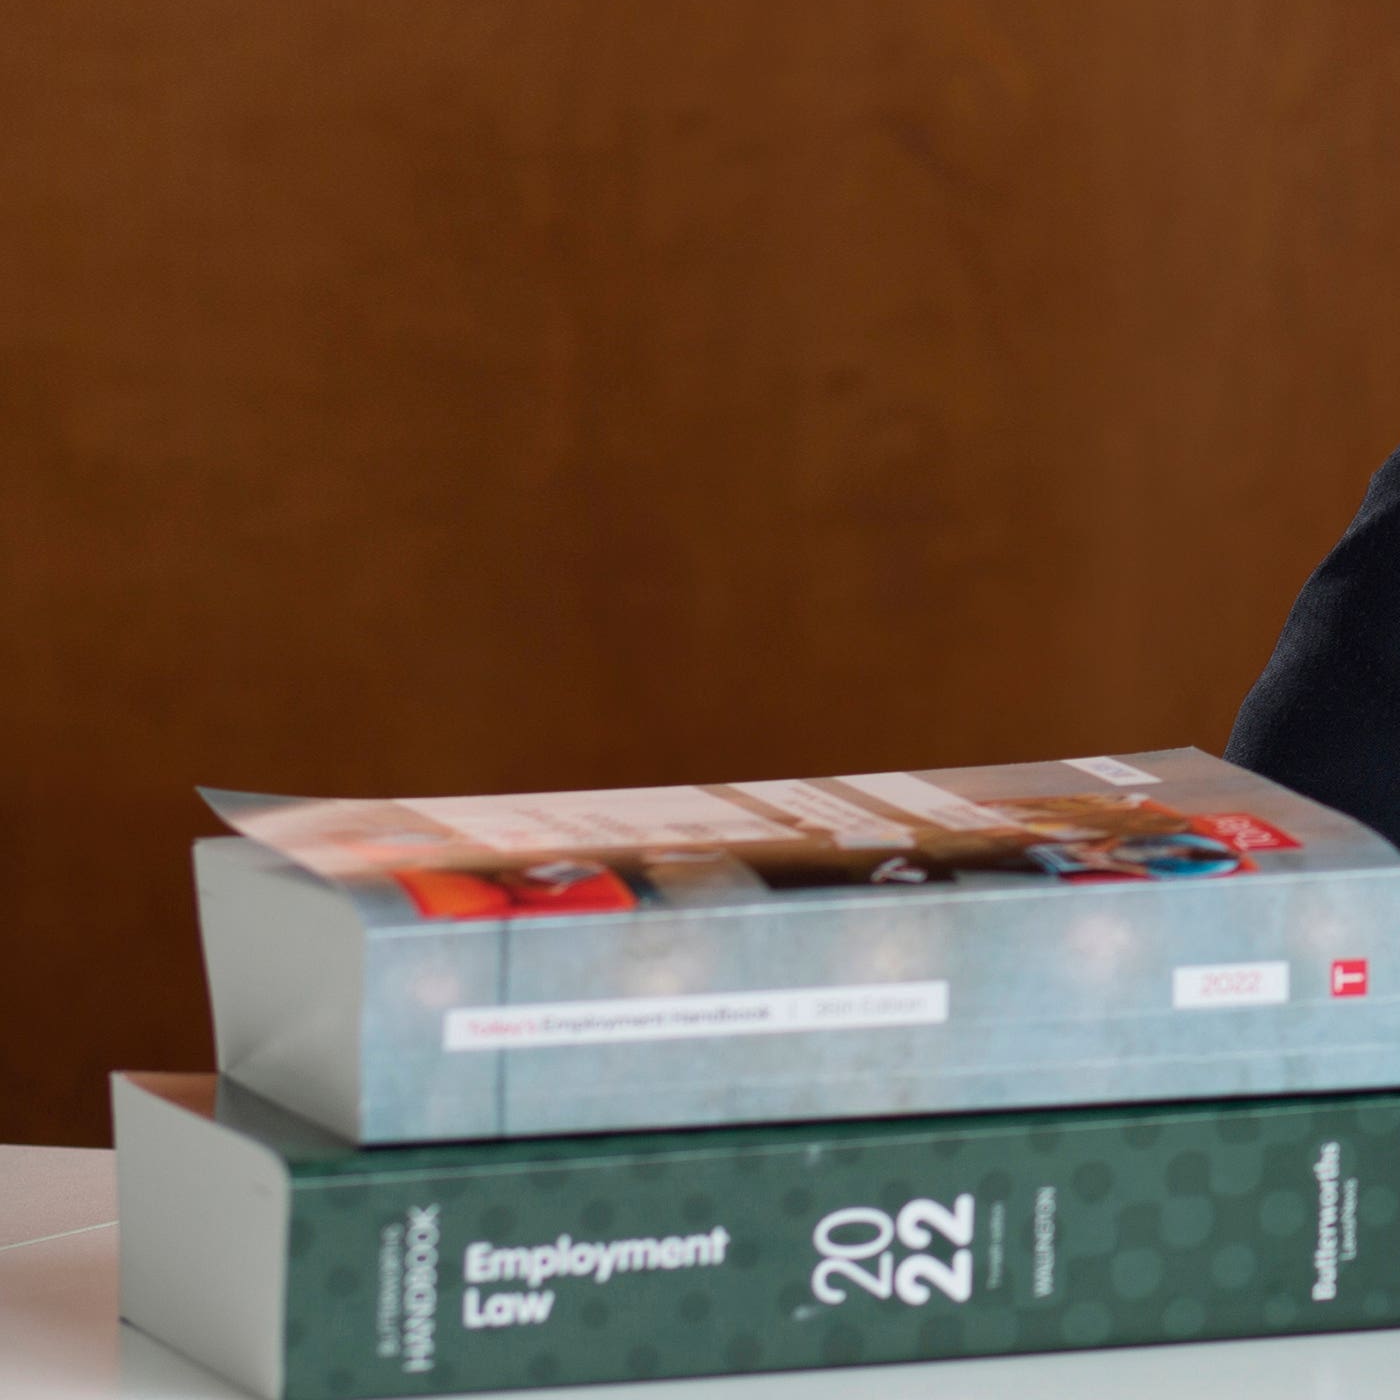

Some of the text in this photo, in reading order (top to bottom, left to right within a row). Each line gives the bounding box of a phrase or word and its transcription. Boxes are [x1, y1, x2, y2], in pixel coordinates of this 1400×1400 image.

[541, 1010, 663, 1035] Employment
[671, 1003, 770, 1025] Handbook
[1201, 970, 1263, 996] 2022
[464, 1225, 731, 1288] Employment
[811, 1206, 894, 1305] 20
[894, 1193, 975, 1306] 22
[1312, 1141, 1341, 1301] Butterworths
[402, 1202, 442, 1373] HANDBOOK
[462, 1286, 556, 1329] Law
